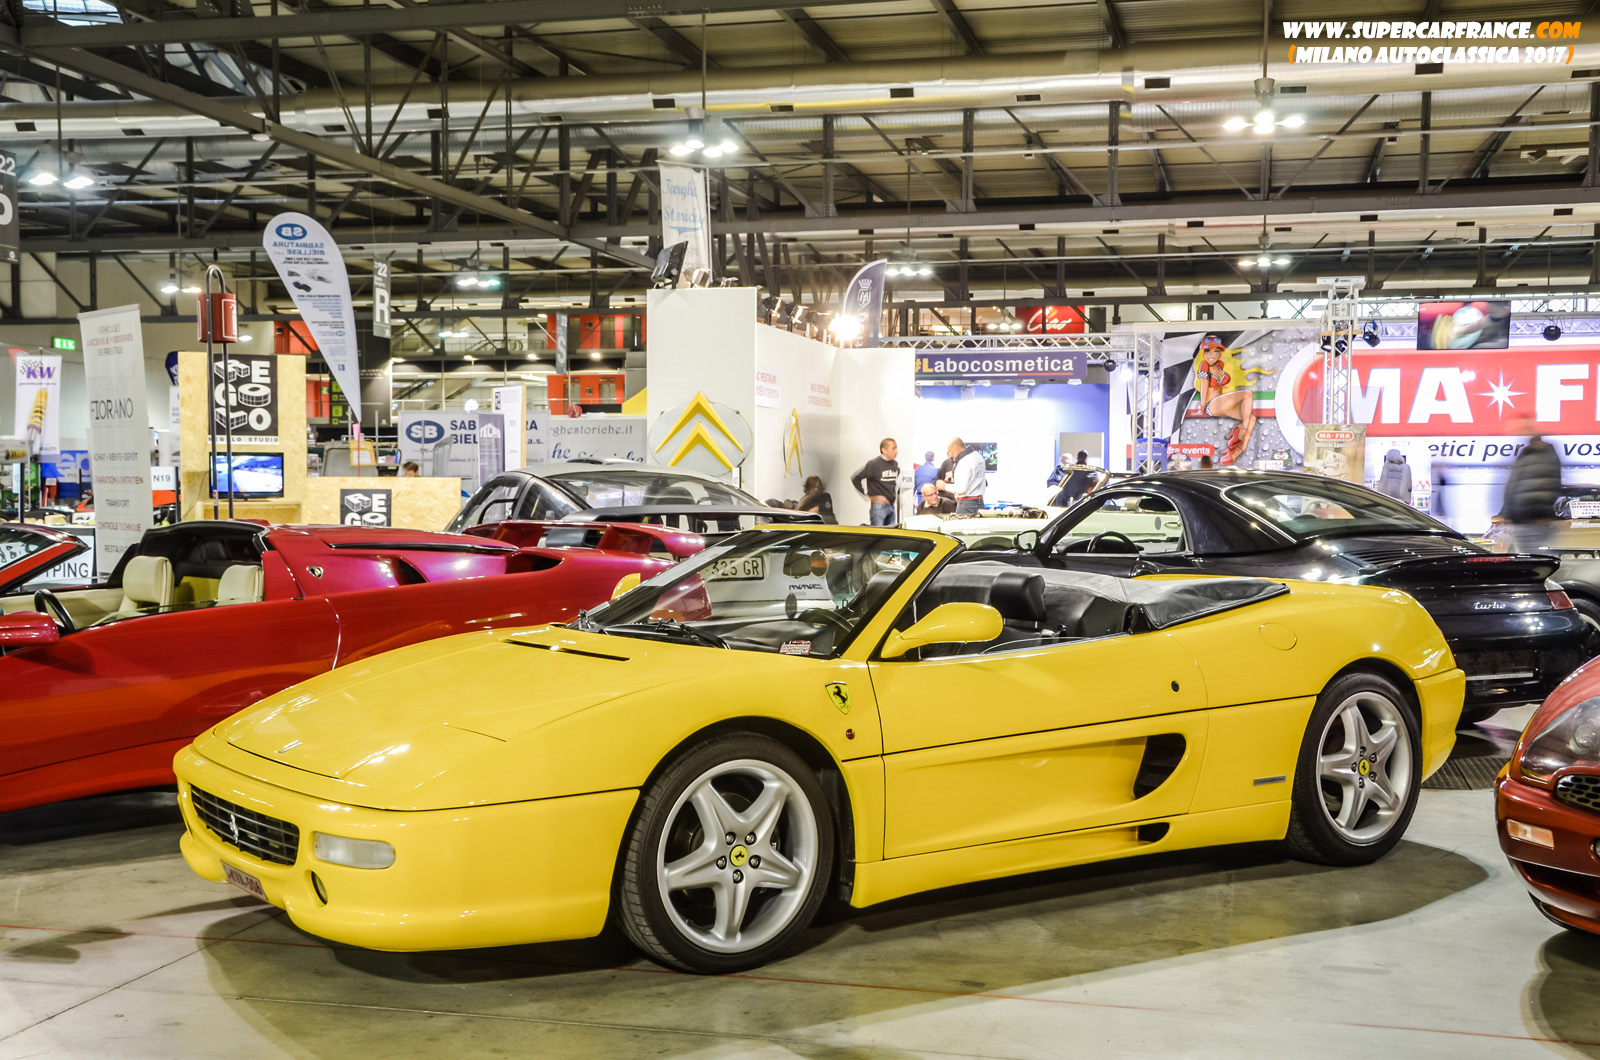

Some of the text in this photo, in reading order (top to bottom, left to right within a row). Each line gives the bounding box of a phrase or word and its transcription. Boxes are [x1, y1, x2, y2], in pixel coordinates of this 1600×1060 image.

[375, 287, 390, 324] R
[915, 355, 1074, 373] #Labocosmetica
[26, 366, 55, 379] KW
[1535, 363, 1600, 423] F
[91, 398, 134, 420] FIORANO
[410, 424, 438, 438] SB
[550, 424, 633, 437] ghestoriche.it
[1182, 446, 1211, 455] events
[153, 474, 171, 482] N19
[743, 559, 760, 576] GR
[1474, 601, 1506, 610] turbo
